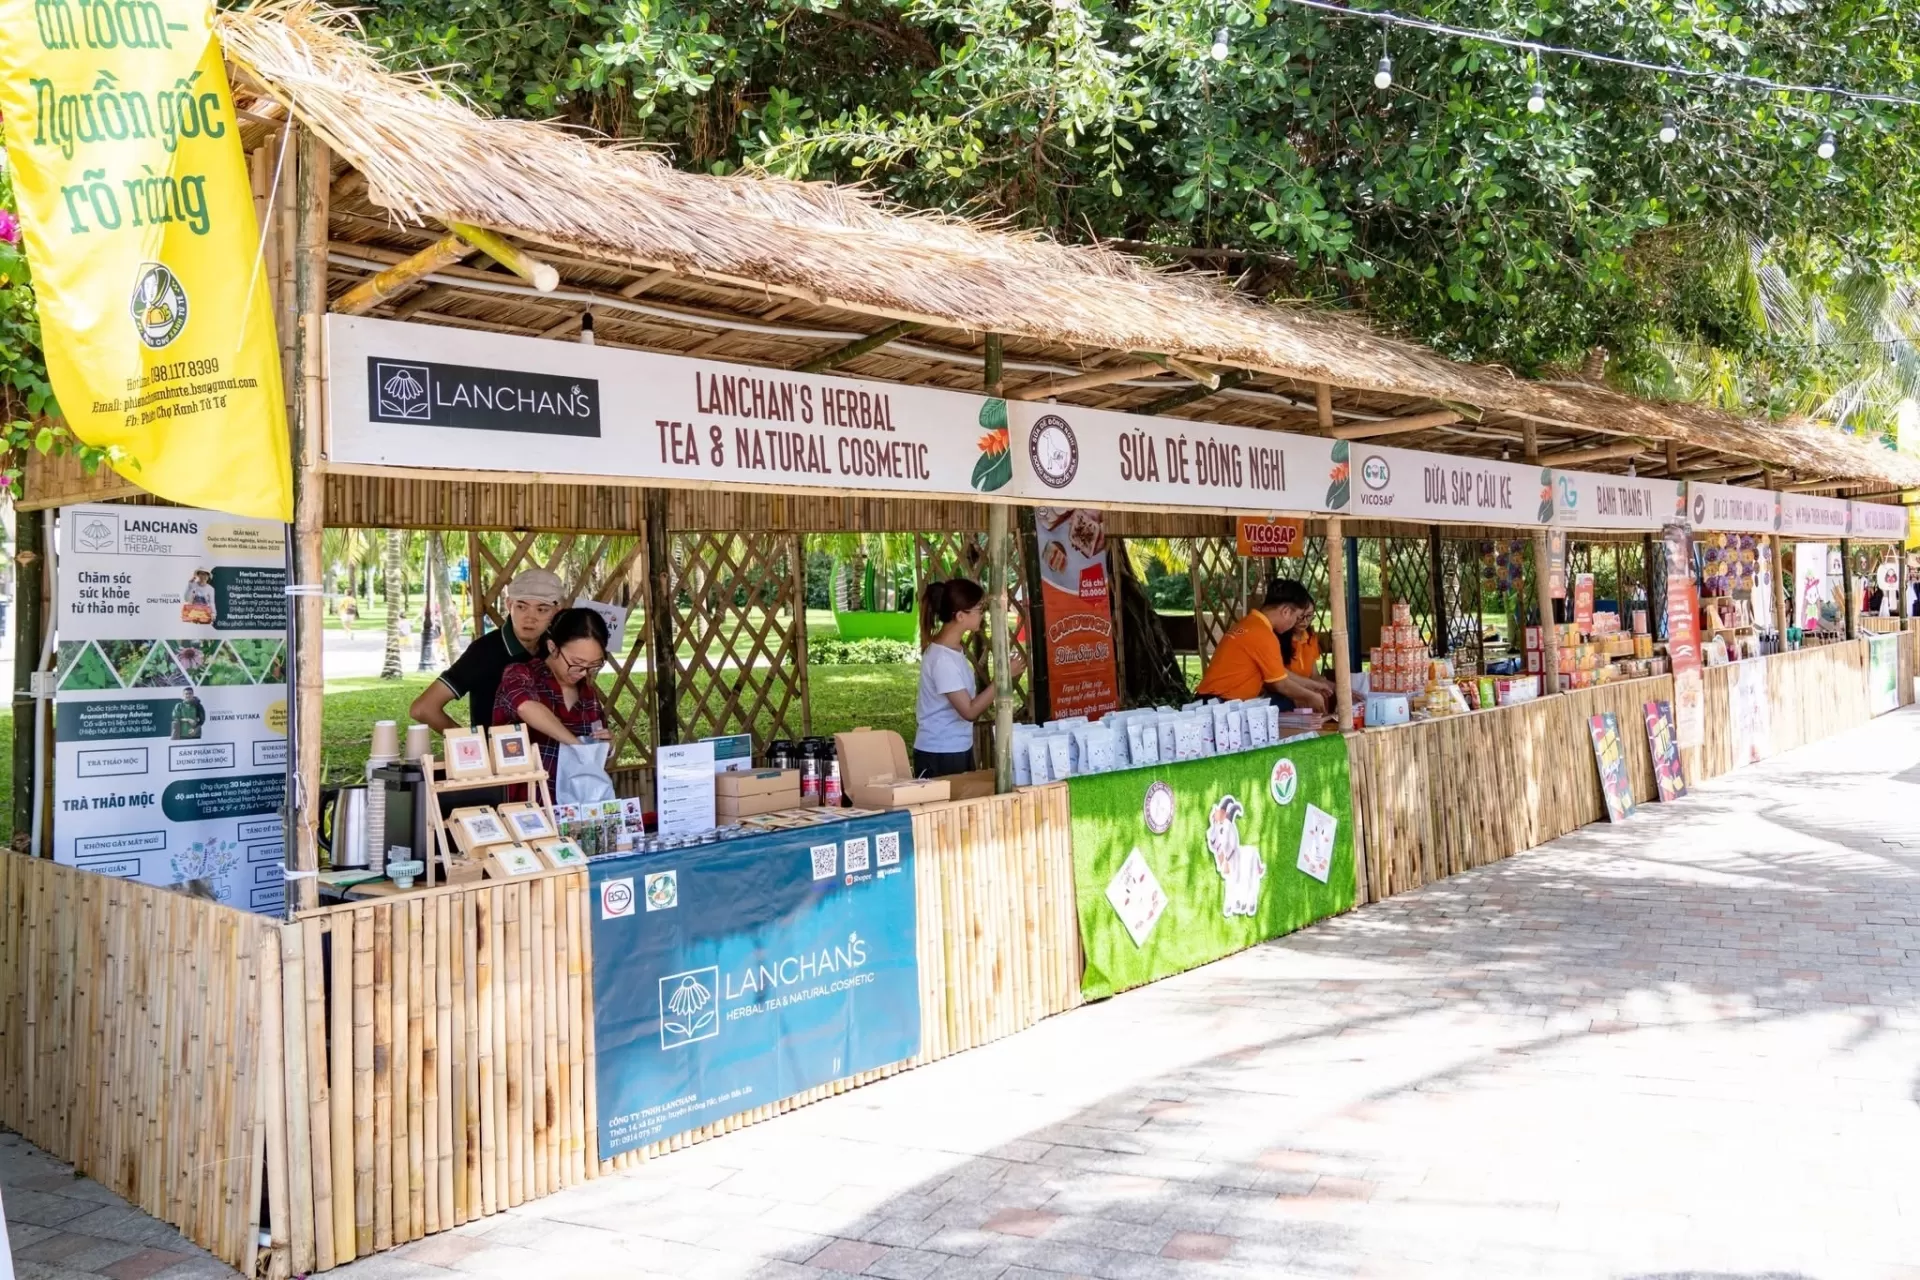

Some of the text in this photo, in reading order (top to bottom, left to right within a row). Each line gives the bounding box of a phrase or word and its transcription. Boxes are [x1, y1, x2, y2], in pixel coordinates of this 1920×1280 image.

[30, 70, 225, 160] Nguồn gốc
[61, 165, 210, 235] rõ ràng
[151, 357, 219, 384] 098.117.8399
[156, 404, 171, 419] Chợ
[695, 371, 896, 432] LANCHAN'S HERBAL
[655, 420, 931, 480] TEA & NATURAL COSMETIC
[1119, 427, 1286, 491] SỮA DÊ ĐÔNG NGHI
[1424, 464, 1447, 505] DỪA
[1451, 467, 1472, 506] SÁP
[123, 534, 160, 544] HERBAL
[1244, 524, 1297, 544] VICOSAP
[123, 543, 172, 554] THERAPIST
[78, 571, 132, 584] Chăm sóc
[79, 586, 130, 599] sức khỏe
[71, 601, 141, 616] từ thảo mộc
[62, 791, 155, 811] TRÀ THẢO MỘC
[726, 972, 875, 1021] HERBAL TEA & NATURAL COSMETIC
[629, 1113, 641, 1122] TY
